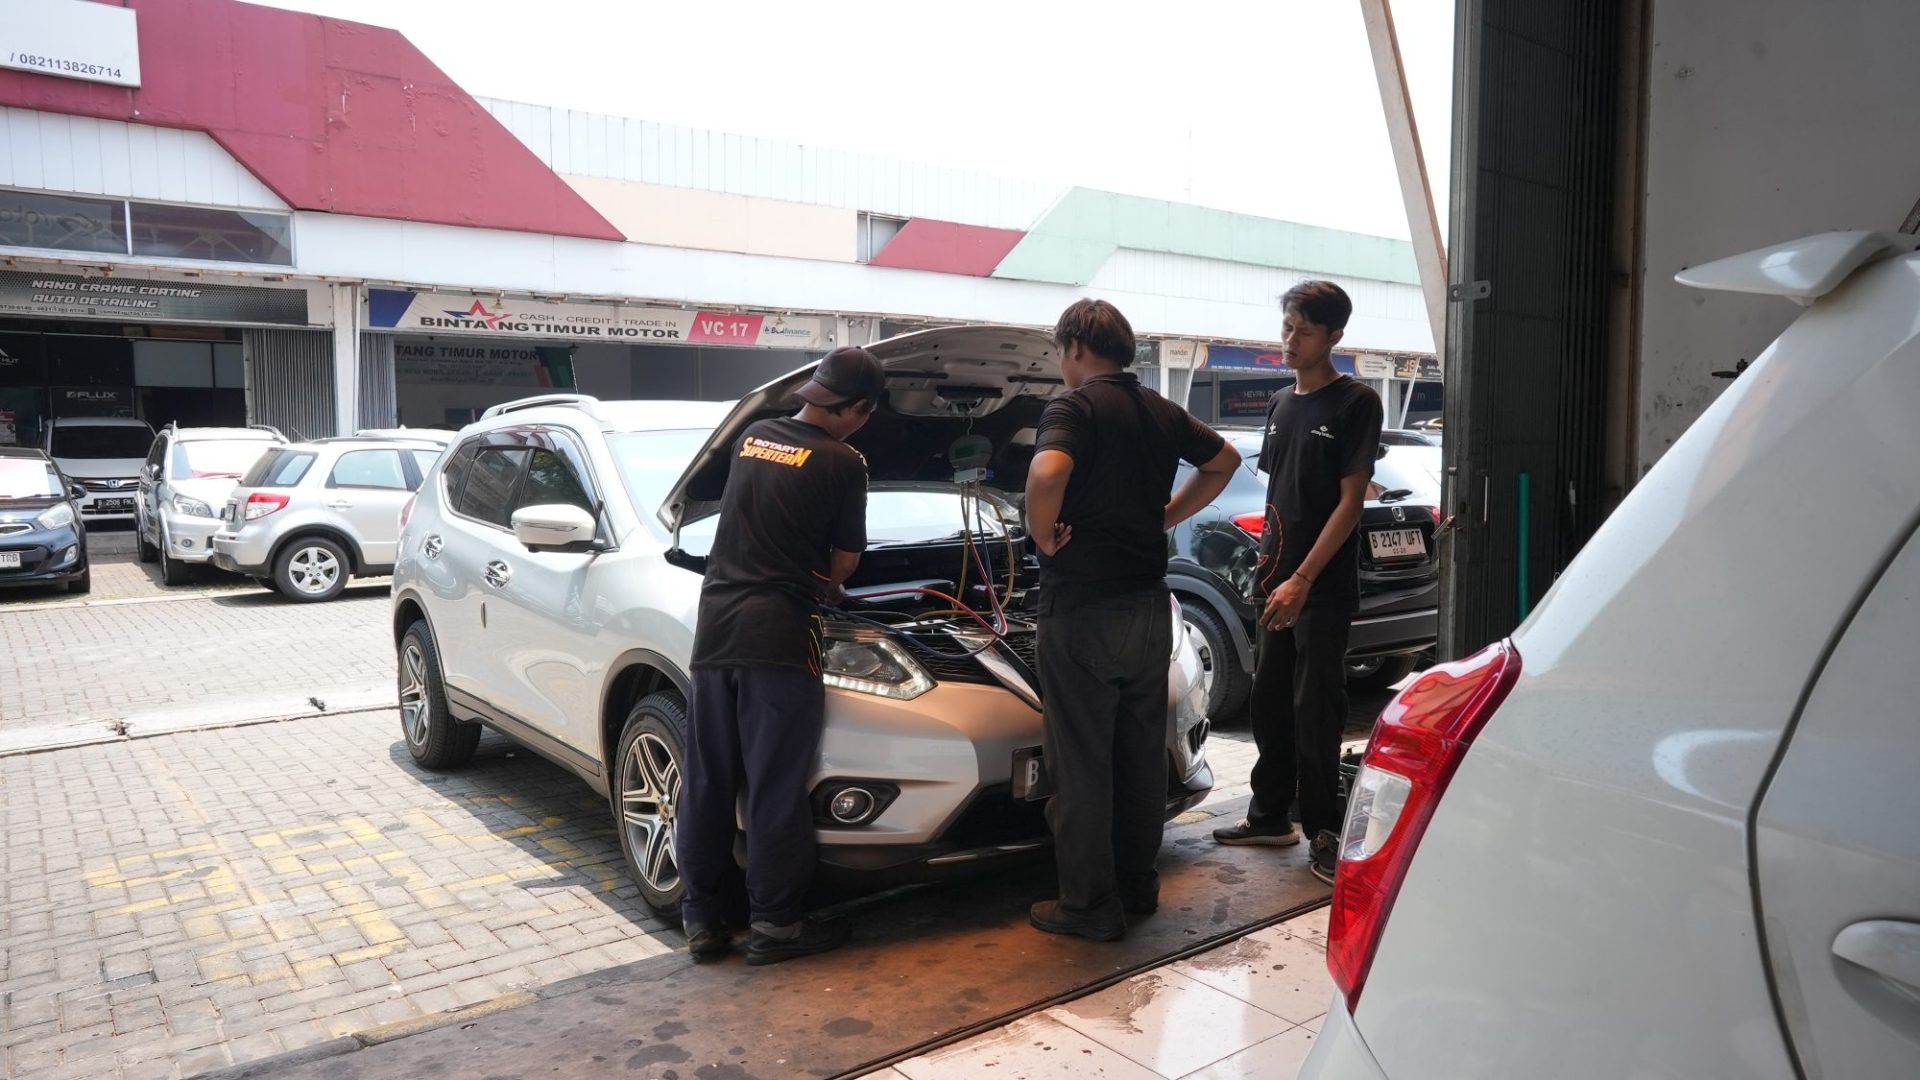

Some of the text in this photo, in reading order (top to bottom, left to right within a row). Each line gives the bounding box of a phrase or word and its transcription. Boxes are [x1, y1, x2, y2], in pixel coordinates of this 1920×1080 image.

[20, 53, 122, 78] 082113826714
[32, 280, 201, 298] NANO CRAMIC COATING
[32, 294, 158, 308] AUTO DETAILING
[519, 313, 555, 321] CASH
[566, 316, 611, 325] CREDIT
[624, 319, 662, 327] TRADE
[701, 320, 748, 337] VC 17
[608, 327, 680, 338] MOTOR
[440, 346, 485, 359] TIMUR
[489, 349, 538, 361] MOTOR
[739, 437, 812, 467] SUPERTEAM
[753, 439, 798, 453] ROTARY
[1371, 530, 1421, 549] B 2147 UFT
[1027, 759, 1040, 786] B
